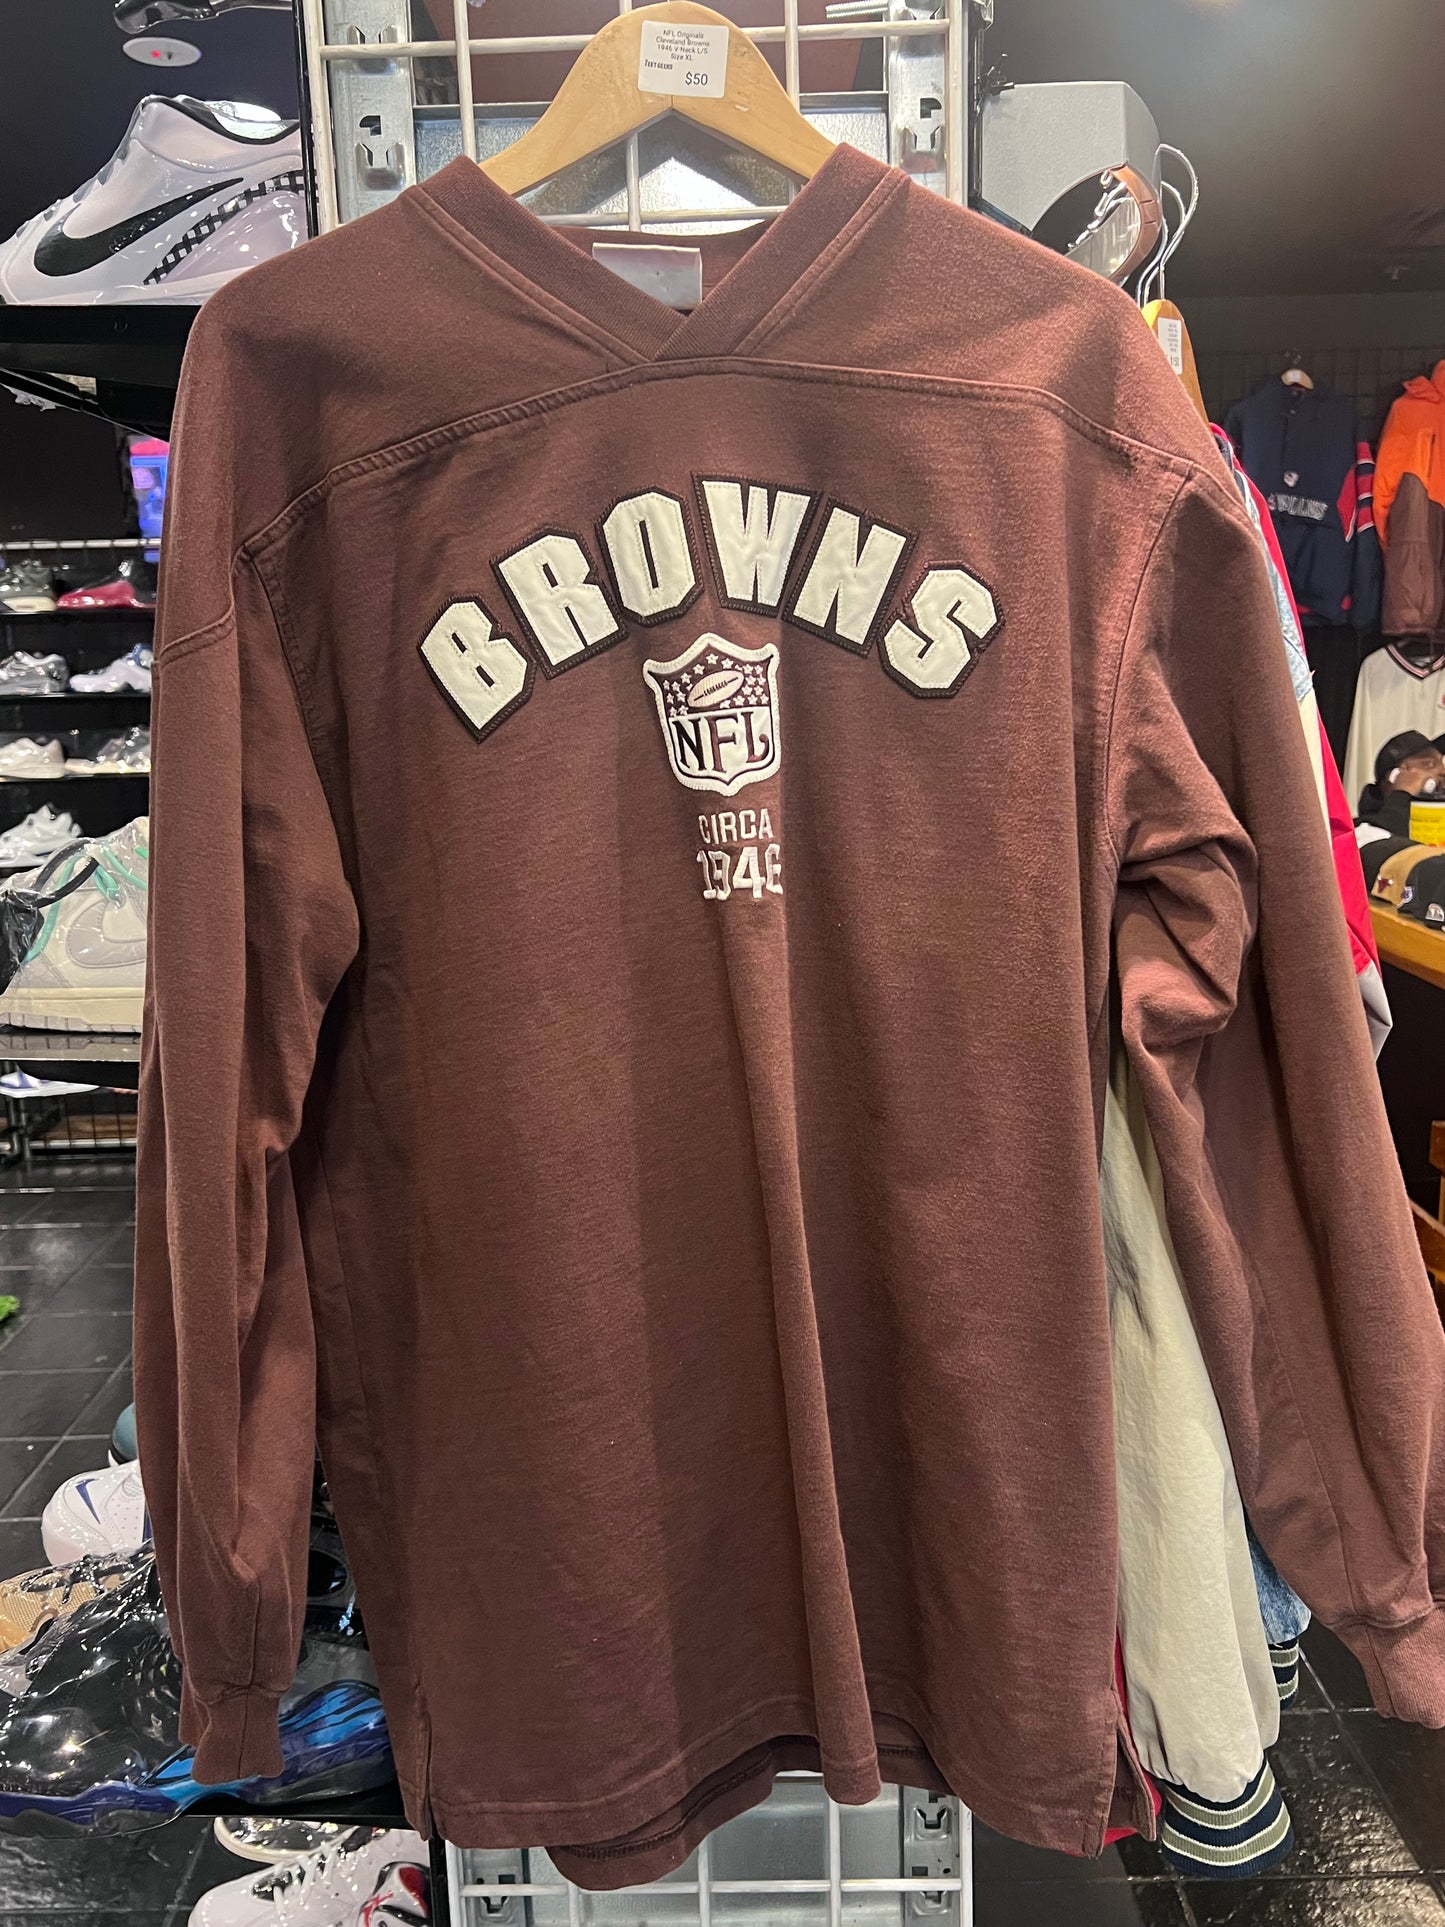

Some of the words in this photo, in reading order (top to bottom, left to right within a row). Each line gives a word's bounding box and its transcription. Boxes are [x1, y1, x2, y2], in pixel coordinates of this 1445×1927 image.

[656, 36, 686, 46] Cleveland
[687, 39, 710, 47] Browns
[663, 29, 675, 37] NFL
[677, 30, 704, 39] Originals
[657, 43, 672, 52] 1946
[680, 46, 695, 54] Neck
[671, 53, 684, 61] Size
[685, 71, 708, 86] $50
[418, 473, 1004, 742] BROWNS
[671, 710, 771, 773] NFL
[698, 808, 774, 845] CIRCA
[696, 843, 784, 901] 1946
